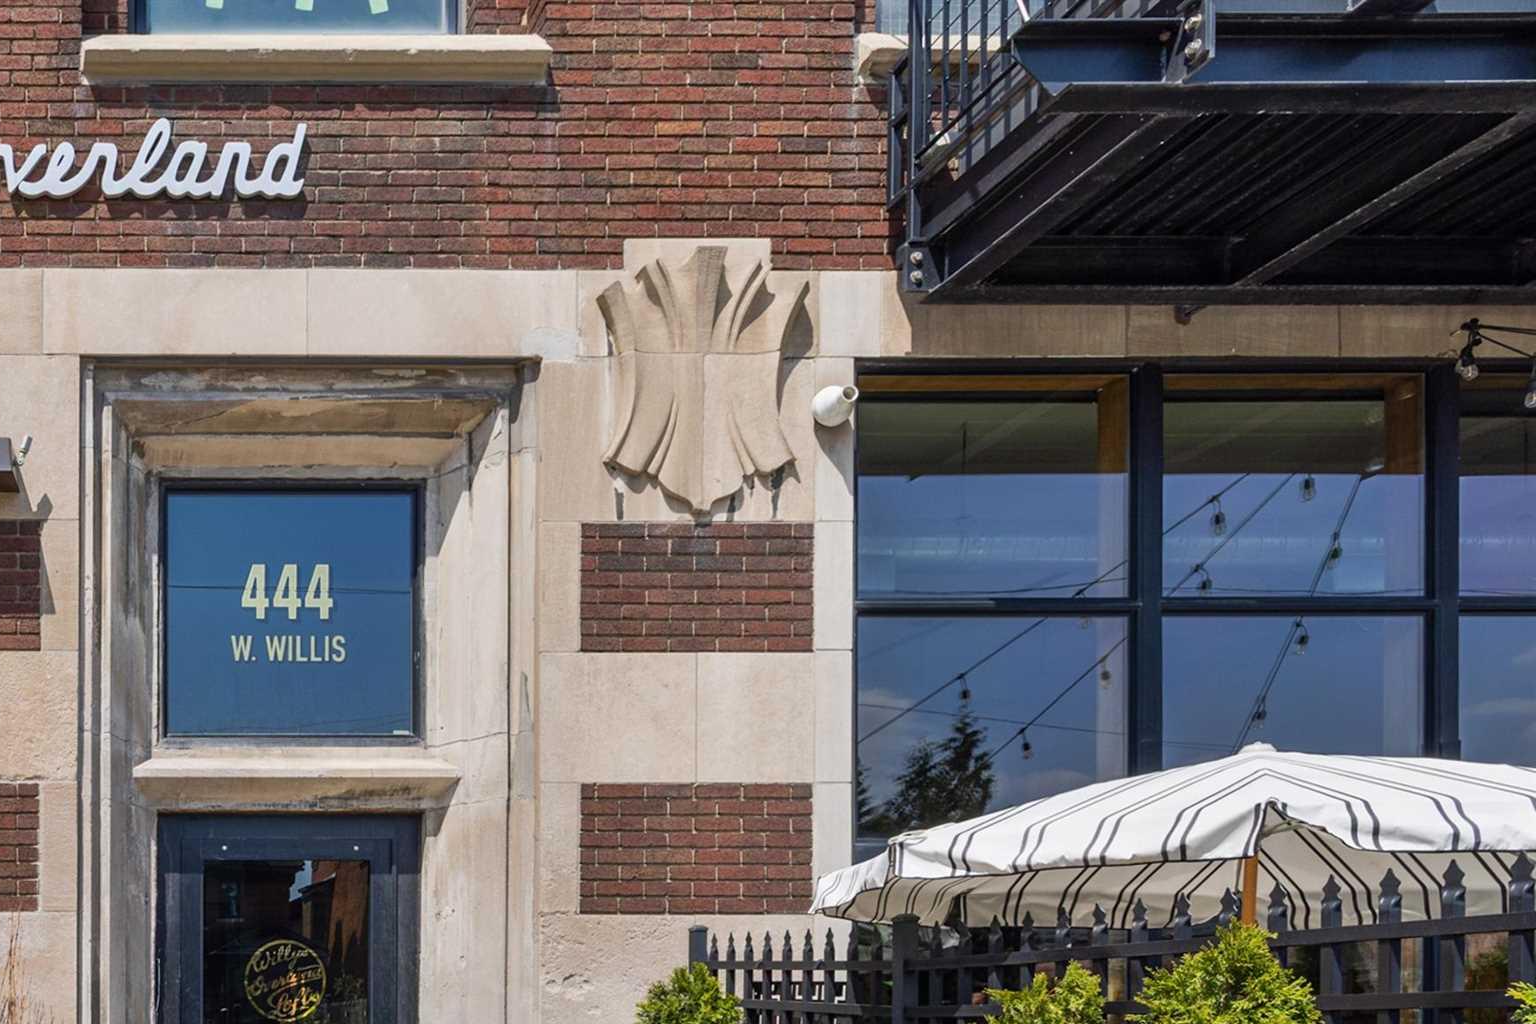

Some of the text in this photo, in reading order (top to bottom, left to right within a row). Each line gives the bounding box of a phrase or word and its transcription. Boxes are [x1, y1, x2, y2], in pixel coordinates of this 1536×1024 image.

[241, 563, 334, 620] 444
[230, 635, 347, 663] W. WILLIS
